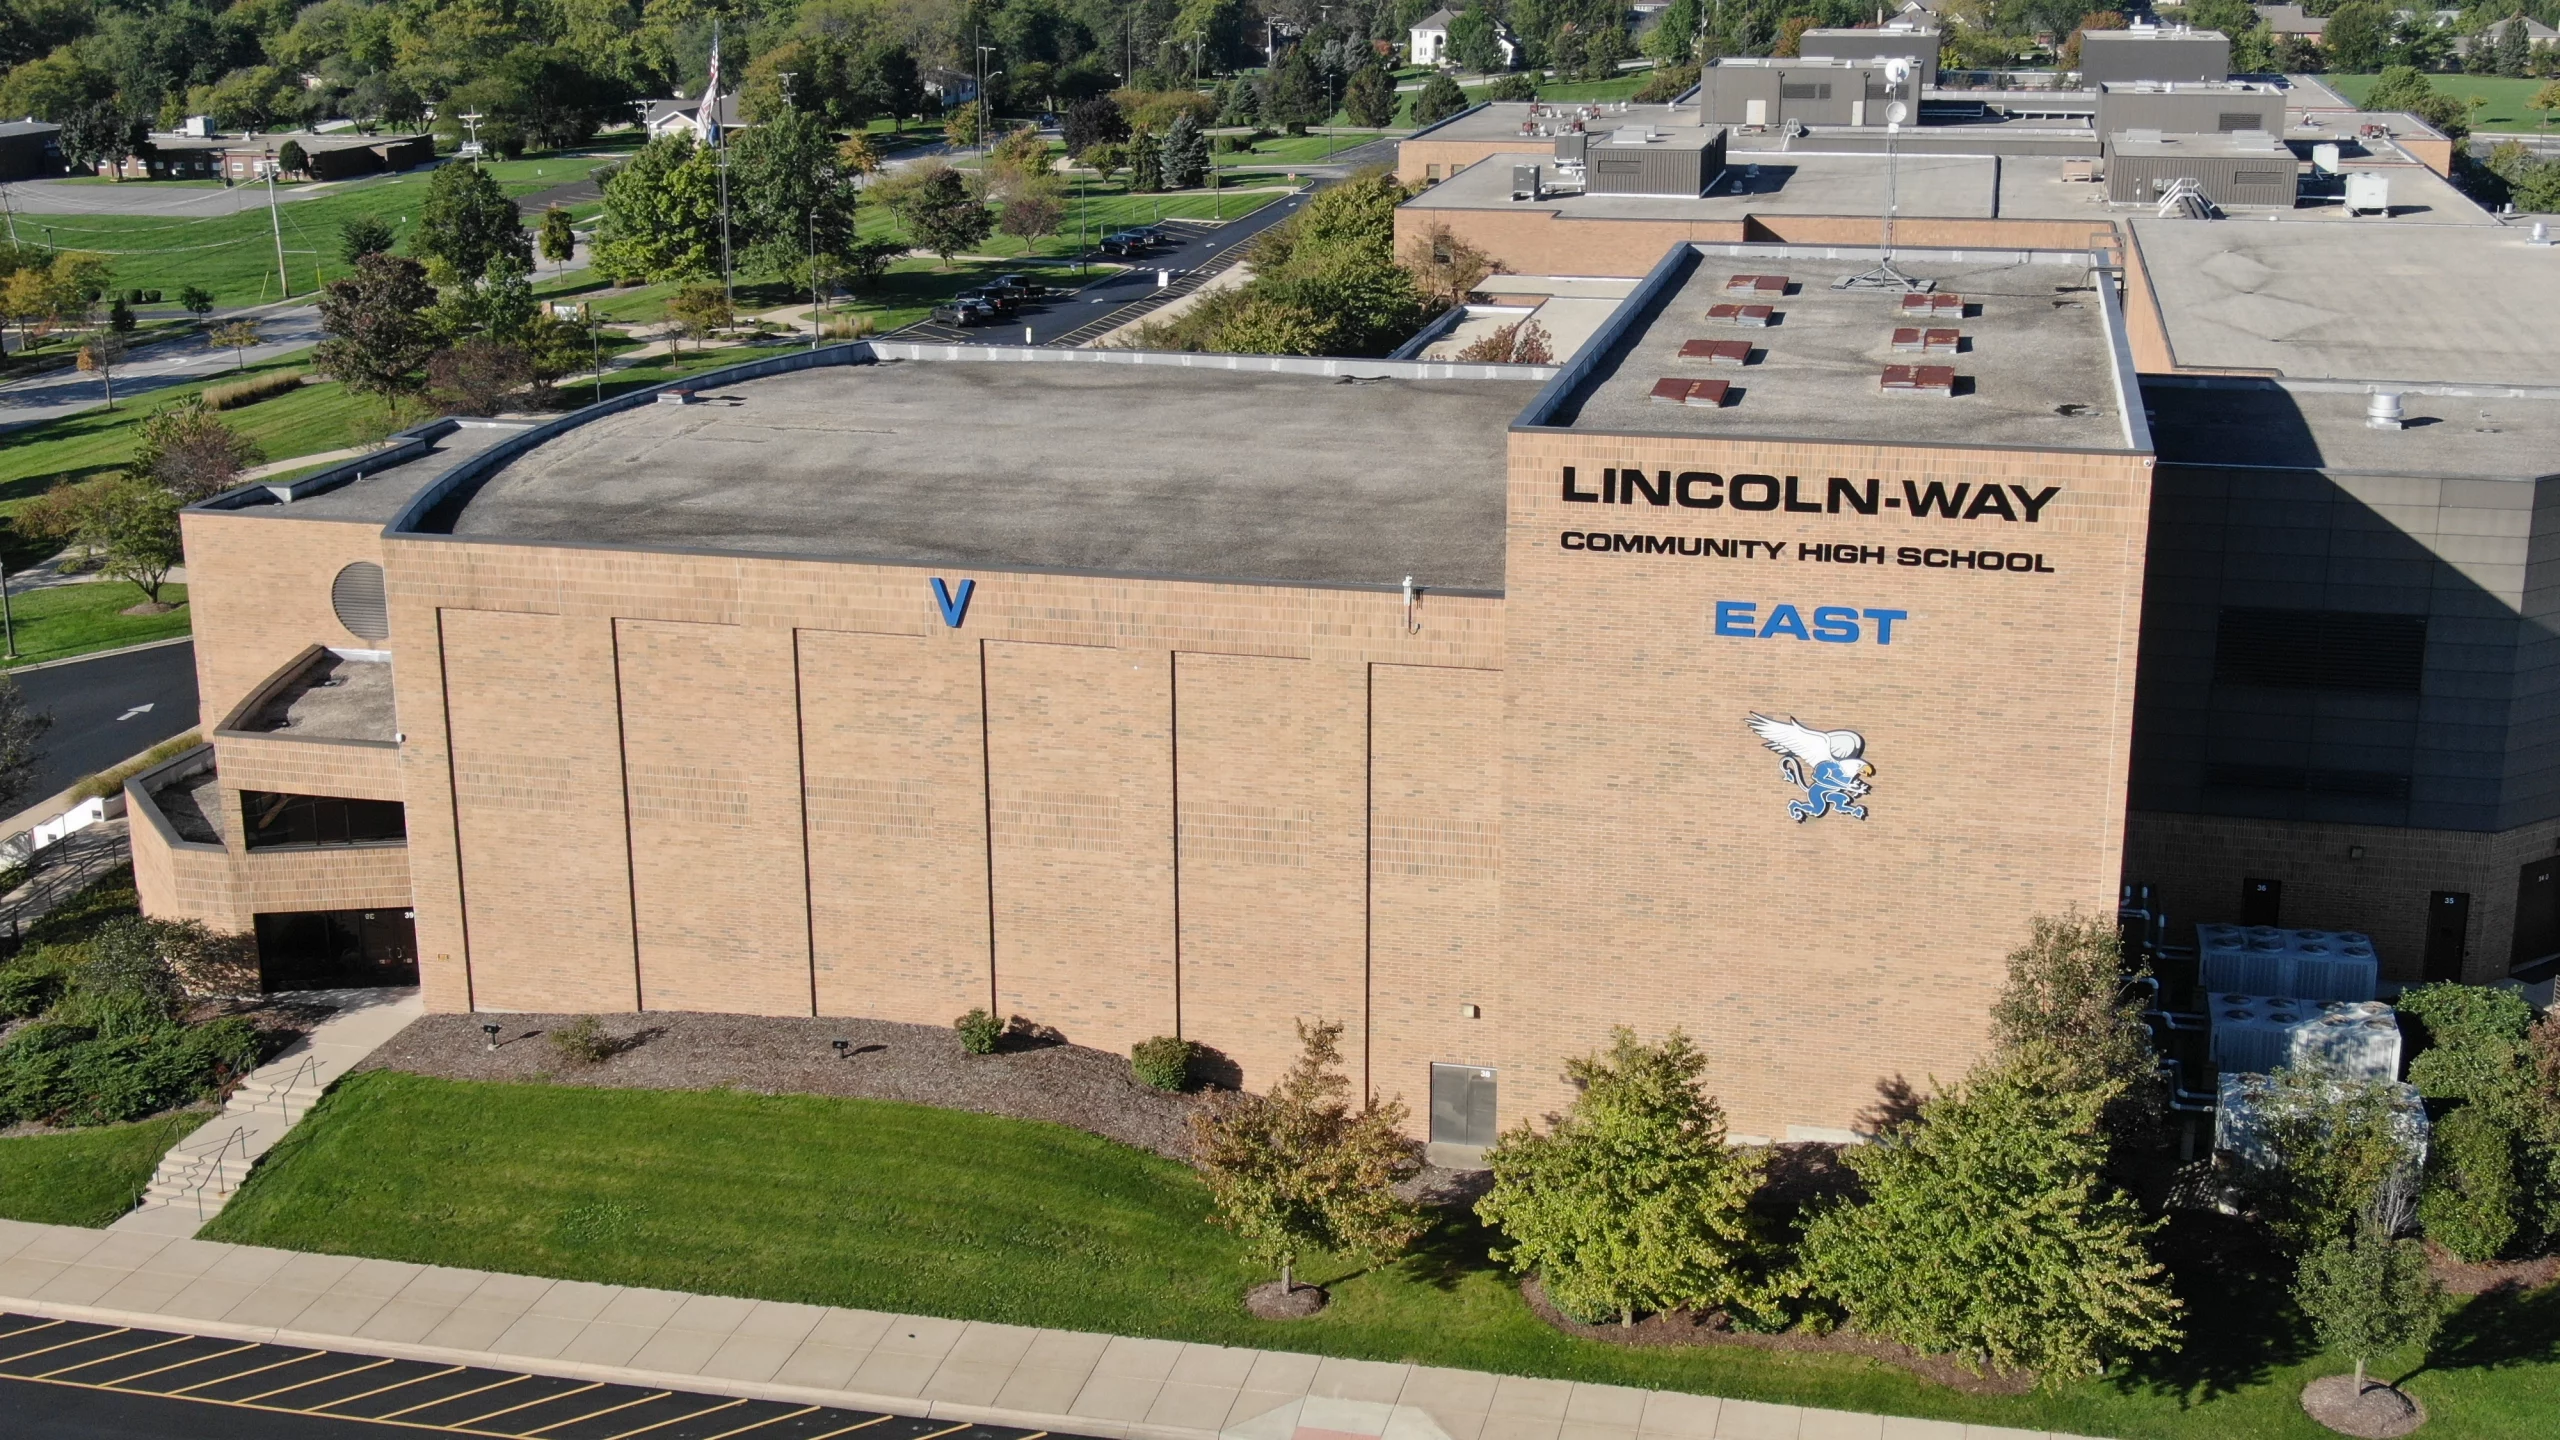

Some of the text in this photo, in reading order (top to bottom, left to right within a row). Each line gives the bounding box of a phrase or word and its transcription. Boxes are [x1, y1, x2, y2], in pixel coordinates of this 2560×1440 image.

[1562, 466, 2061, 523] LINCOLN-WAY
[1560, 531, 2055, 573] COMMUNITY HIGH SCHOOL
[929, 577, 976, 628] V
[1715, 600, 1909, 645] EAST
